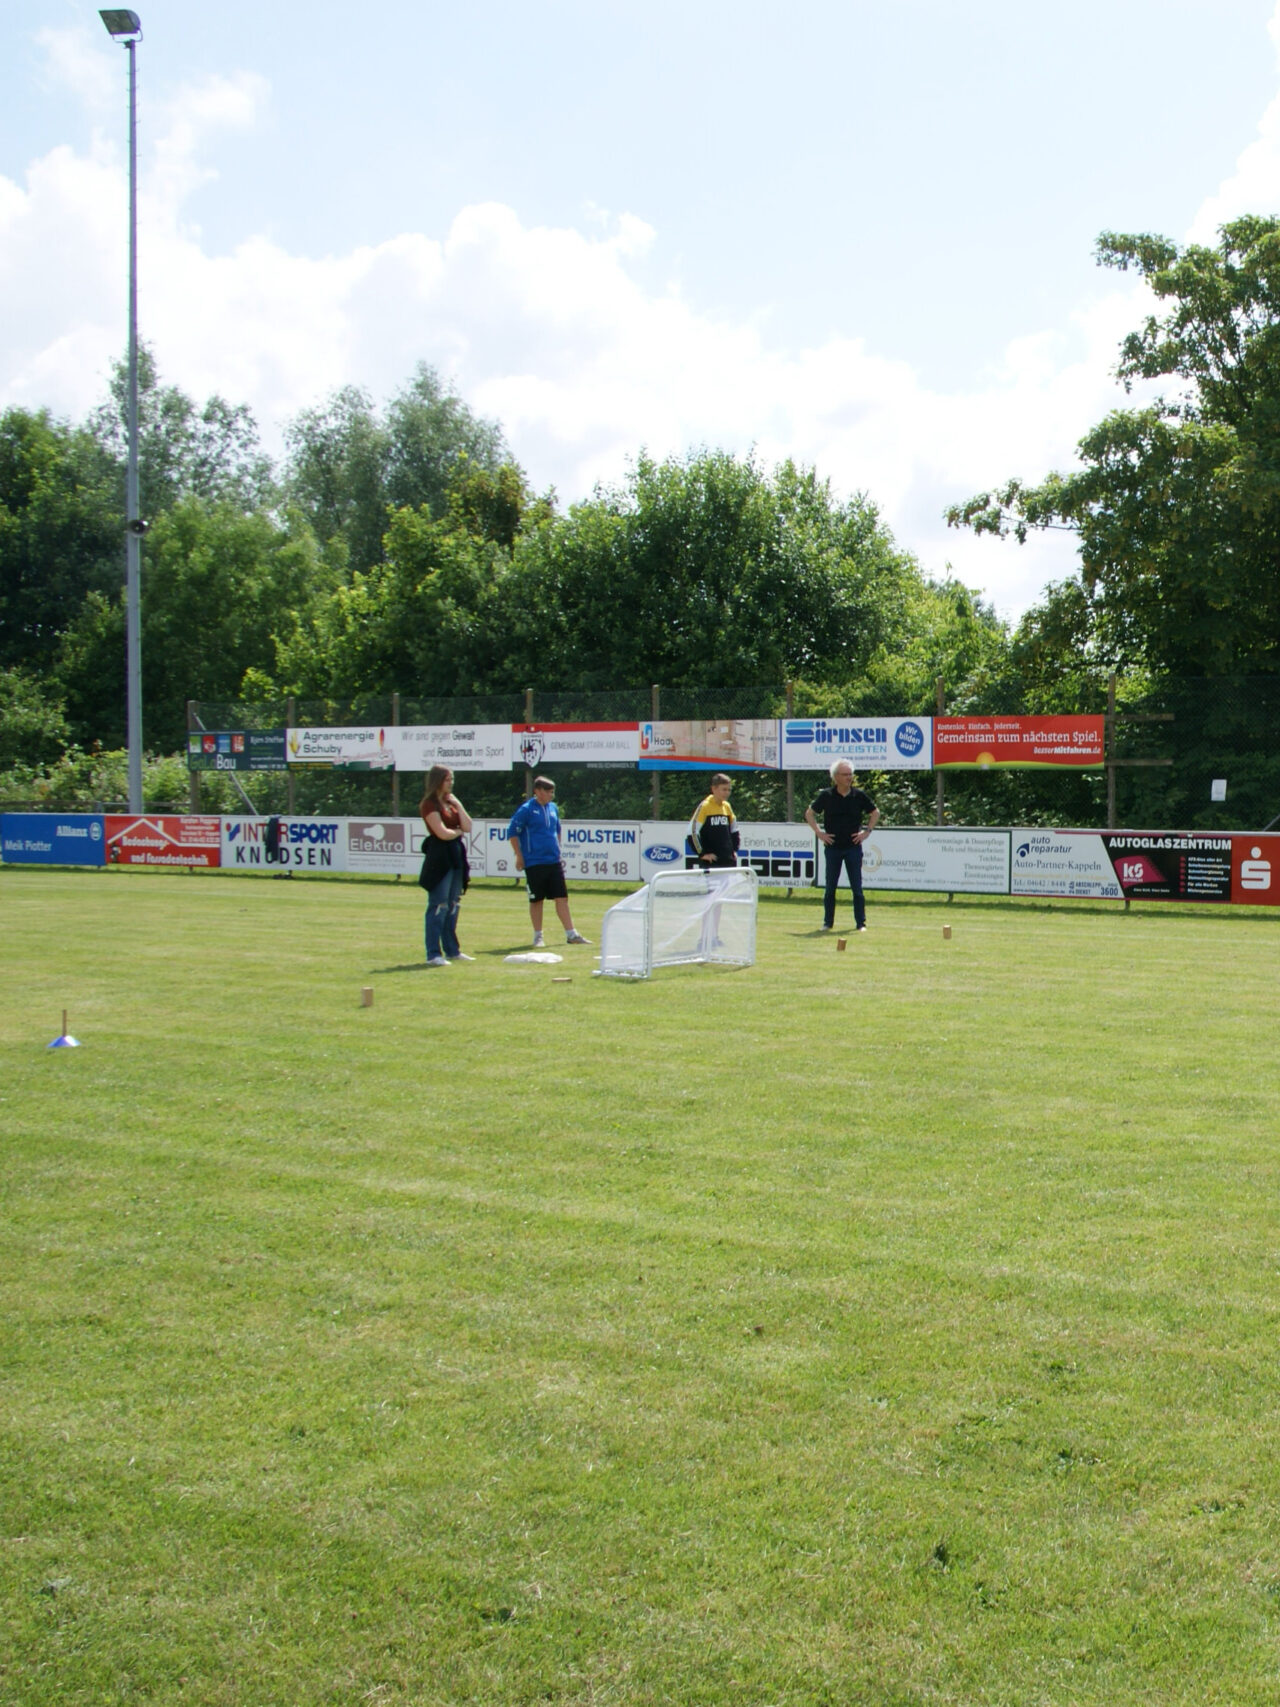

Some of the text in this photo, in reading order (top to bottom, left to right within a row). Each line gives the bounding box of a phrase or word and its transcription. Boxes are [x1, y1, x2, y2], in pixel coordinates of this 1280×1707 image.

[452, 730, 475, 740] Gewalt
[785, 721, 887, 743] Sörnsen
[905, 725, 918, 735] Wir
[303, 731, 375, 743] Agrarenergie
[899, 732, 920, 745] bilden
[937, 731, 1102, 745] Gemeinsam zum nächsten Spiel.
[303, 744, 342, 755] Schuby
[437, 747, 473, 757] Rassismus
[815, 745, 887, 754] HOLZLEISTEN
[900, 742, 916, 751] aus!
[56, 825, 88, 837] Allianz
[567, 829, 636, 844] HOLSTEIN
[350, 838, 404, 852] Elektro
[1031, 836, 1050, 844] auto
[1109, 837, 1232, 850] AUTOGLASZENTRUM
[650, 847, 674, 860] Ford
[1031, 845, 1072, 855] reparatur
[613, 861, 629, 875] 18
[1014, 859, 1102, 872] Auto-Partner-Kappeln
[1100, 887, 1119, 896] 3600
